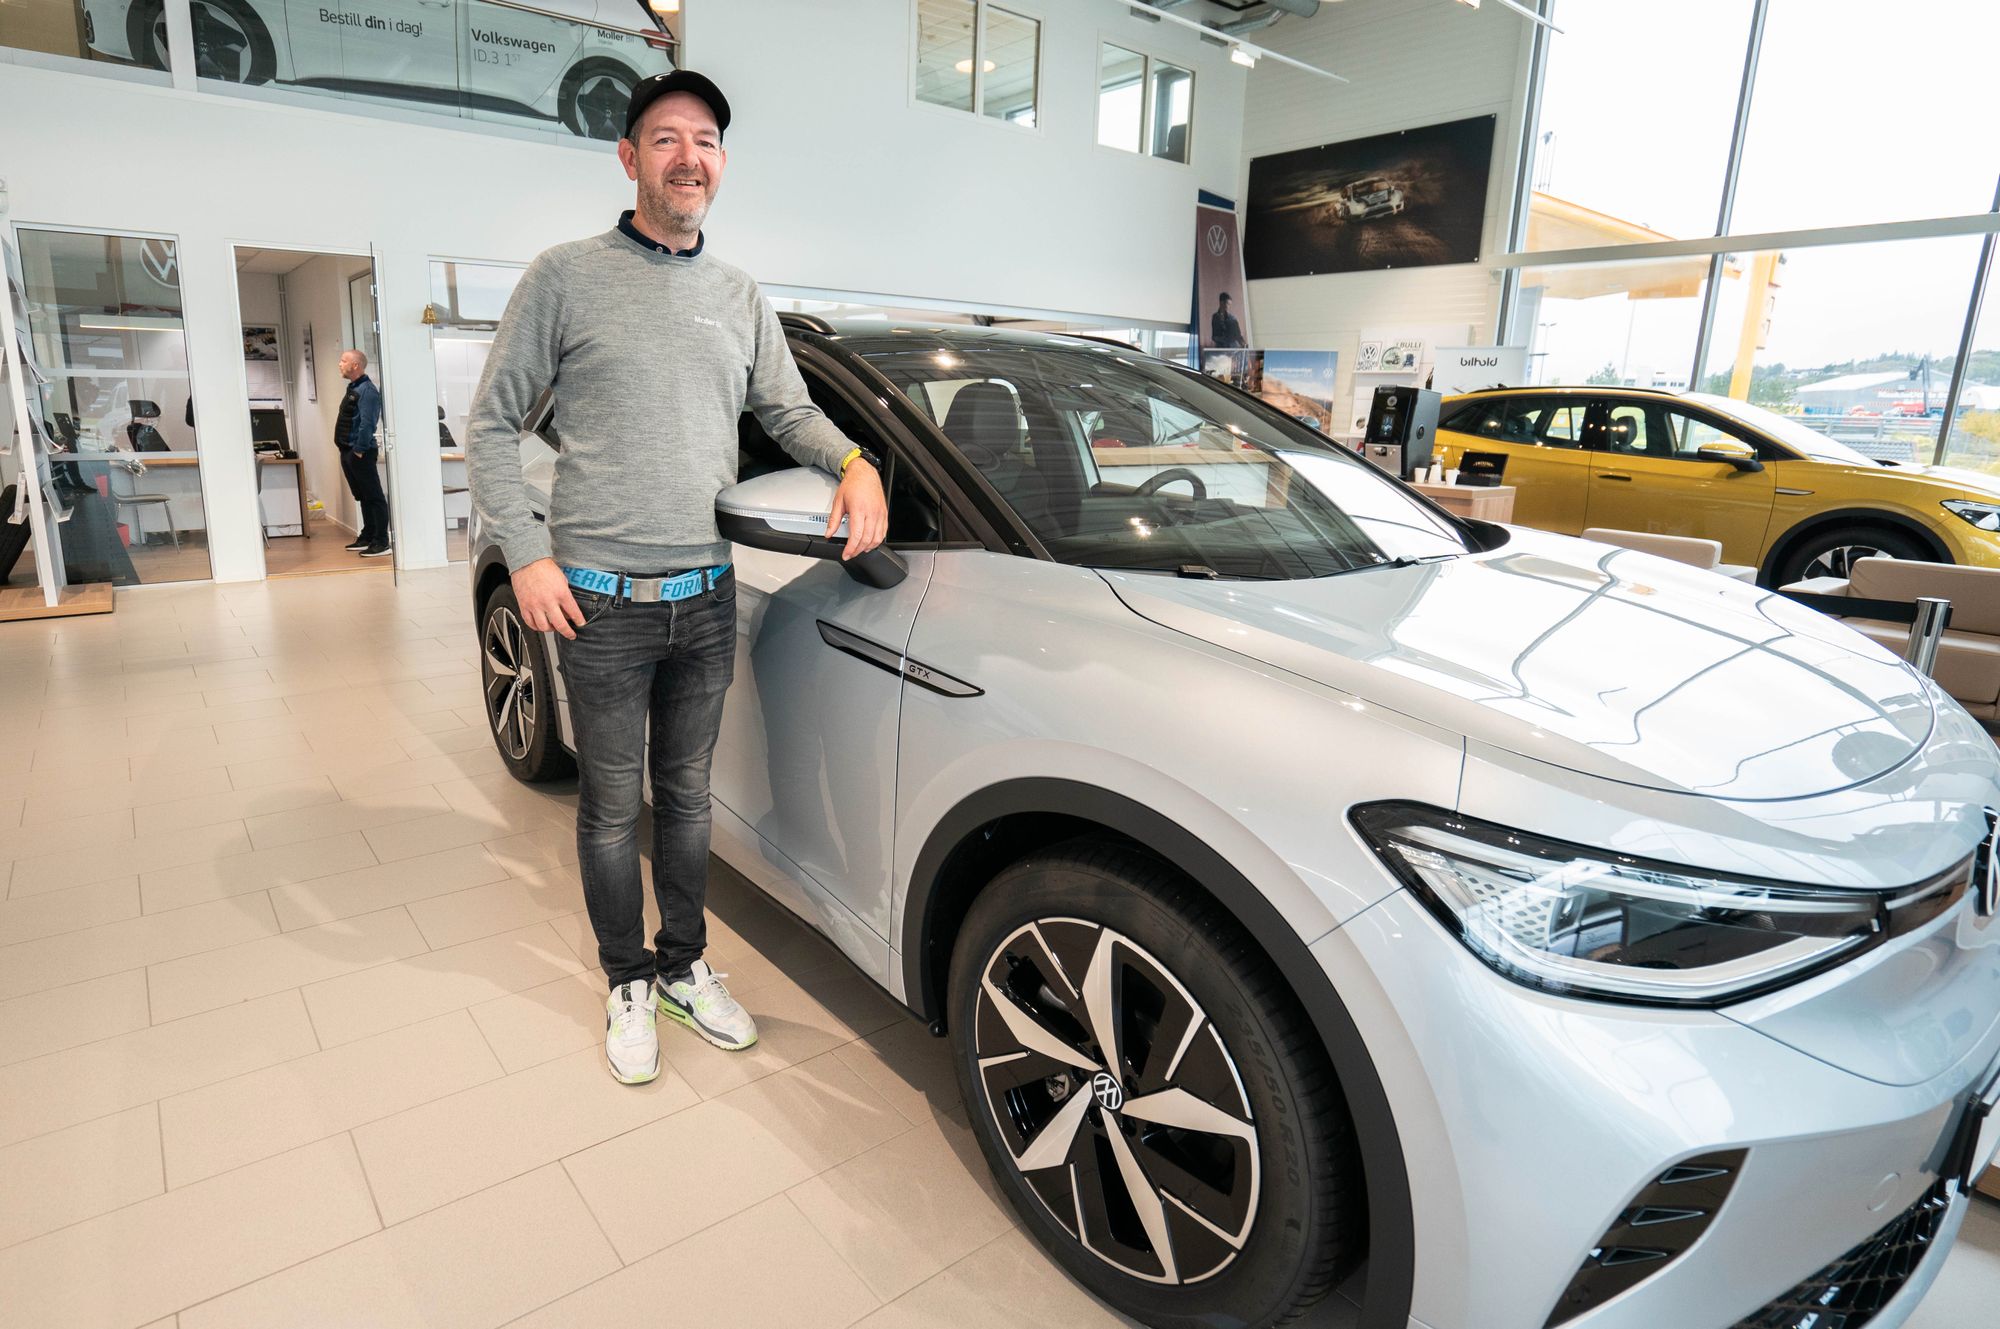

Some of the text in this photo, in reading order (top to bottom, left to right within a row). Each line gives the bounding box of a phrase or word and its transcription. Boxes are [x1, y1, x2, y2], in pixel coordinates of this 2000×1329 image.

[319, 8, 423, 38] Bestill din i dag!
[471, 28, 556, 54] Volkswagen
[473, 48, 499, 65] ID.3
[1460, 357, 1498, 367] bilhold
[909, 664, 931, 680] GTX
